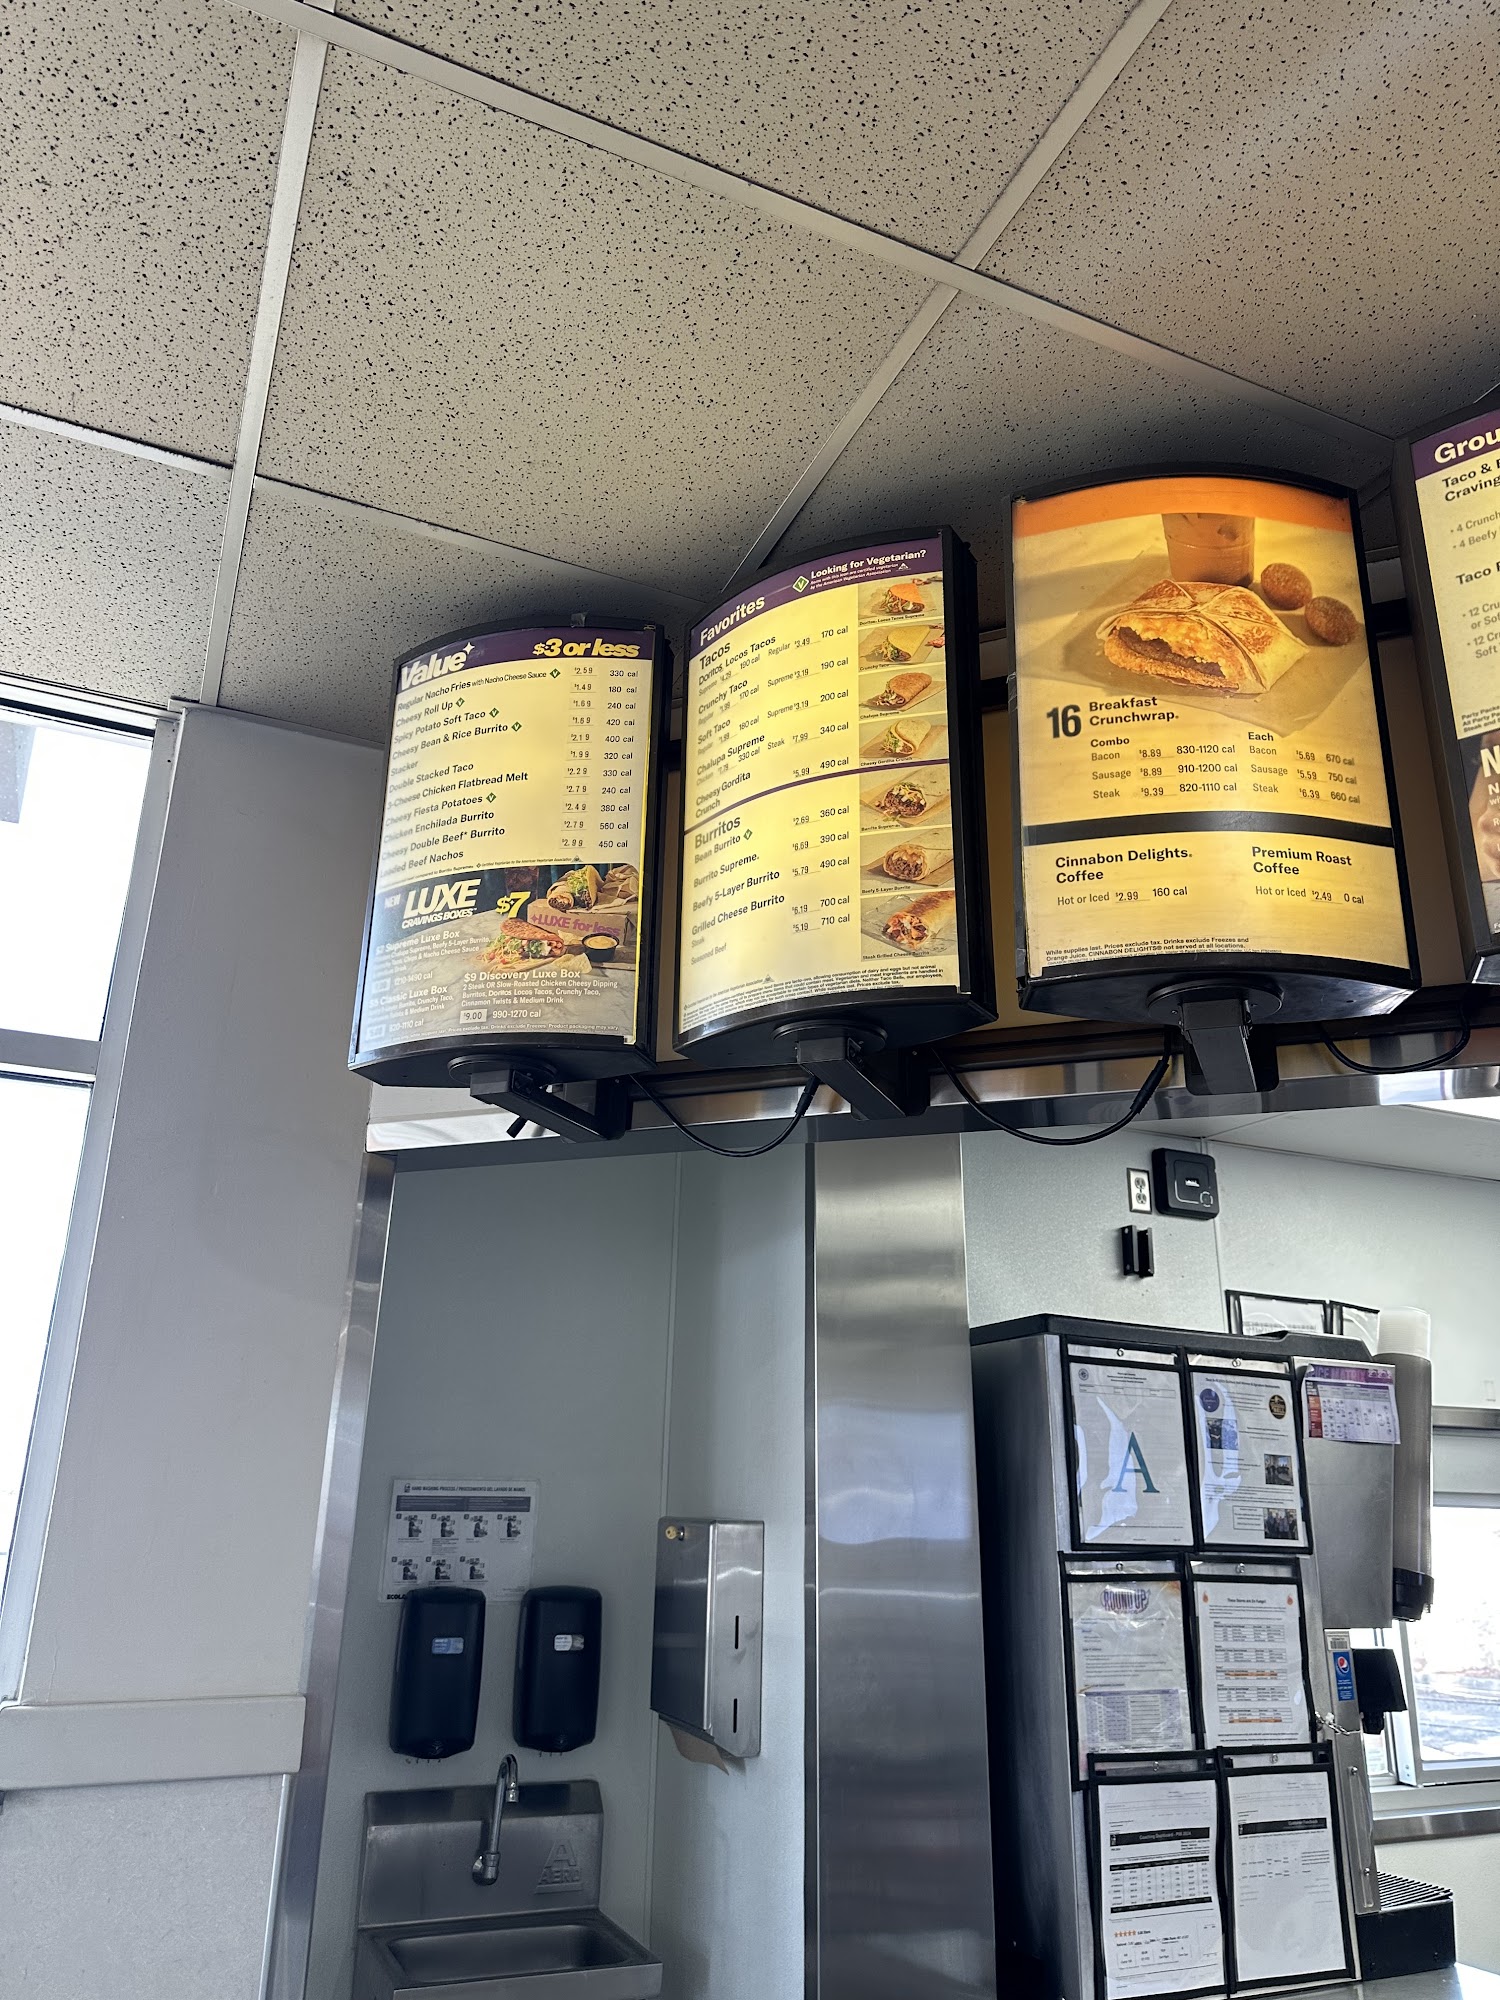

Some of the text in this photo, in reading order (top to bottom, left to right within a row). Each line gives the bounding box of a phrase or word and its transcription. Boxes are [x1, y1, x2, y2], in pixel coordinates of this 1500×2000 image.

[1442, 463, 1492, 488] Taco &
[1468, 530, 1498, 546] Beefy
[811, 550, 927, 579] Looking for Vegetarian?
[1456, 567, 1492, 585] Taco
[700, 596, 765, 647] Favorites
[1469, 606, 1480, 618] 12
[821, 625, 849, 639] 170 cal
[1473, 635, 1484, 646] 12
[563, 642, 592, 656] or
[591, 638, 640, 658] less
[699, 641, 731, 670] Tacos
[725, 648, 749, 668] Locos
[750, 635, 776, 653] Tacos
[1475, 644, 1498, 659] Soft
[401, 651, 467, 691] Value
[821, 658, 849, 671] 190 cal
[767, 673, 793, 687] Supreme
[397, 695, 424, 712] Regular
[424, 687, 450, 700] Nacho
[450, 680, 471, 693] Fries
[698, 679, 748, 714] Crunchy Taco
[820, 689, 849, 703] 200 cal
[395, 702, 453, 727] Cheesy Roll Up
[1046, 696, 1158, 739] 16 Breakfast
[393, 711, 486, 745] Spicy Potato Soft Taco
[697, 719, 730, 745] Soft Taco
[820, 721, 849, 735] 340 cal
[1248, 732, 1274, 742] Each
[392, 723, 508, 760] Cheesy Bean Rice Burrito
[1091, 737, 1130, 748] Combo
[697, 735, 765, 776] Chalupa Supreme
[1091, 744, 1235, 761] Bacon 830-1120 cal
[1249, 745, 1355, 766] Bacon 670 cal
[390, 760, 418, 777] Stacker
[820, 757, 849, 769] 490 cal
[1092, 763, 1238, 780] Sausage 910-1200 cal
[389, 763, 474, 793] Double Stacked Taco
[1251, 764, 1357, 785] Sausage 750 cal
[387, 772, 528, 810] 3-Cheese Chicken Flatbread Melt
[696, 771, 751, 806] Cheesy Gordita
[1093, 782, 1237, 799] Steak 820-1110 cal
[1253, 783, 1360, 804] Steak cal
[385, 795, 483, 827] Cheesy Fiesta Potatoes
[837, 805, 849, 815] cal
[384, 811, 494, 844] Chicken Enchilada Burrito
[695, 816, 741, 849] Burritos
[381, 845, 408, 861] Cheesy
[410, 836, 440, 852] Double
[470, 826, 505, 839] Burrito
[694, 834, 741, 864] Bean Burrito
[408, 855, 428, 869] Beef
[429, 851, 464, 864] Nachos
[1055, 852, 1123, 869] Cinnabon
[1252, 846, 1352, 866] Premium Roast
[1056, 870, 1104, 883] Coffee
[1253, 862, 1300, 875] Coffee
[693, 870, 718, 888] Burrito
[403, 878, 481, 919] LUXE
[693, 870, 780, 912] Beefy 5-Layer Burrito
[820, 895, 849, 907] 700 cal
[1057, 896, 1075, 906] Hot
[1089, 892, 1110, 902] Iced
[1152, 887, 1170, 897] 160
[1173, 886, 1188, 896] cal
[1256, 886, 1364, 904] Hot or Iced cal
[402, 912, 443, 930] CRAVINGS
[538, 914, 572, 929] LUXE
[573, 918, 593, 933] for
[692, 894, 785, 936] Grilled Cheese Burrito
[464, 969, 580, 983] $9 Discovery Luxe Box
[492, 1009, 541, 1018] 990-1270 cal
[1112, 1431, 1160, 1493] A
